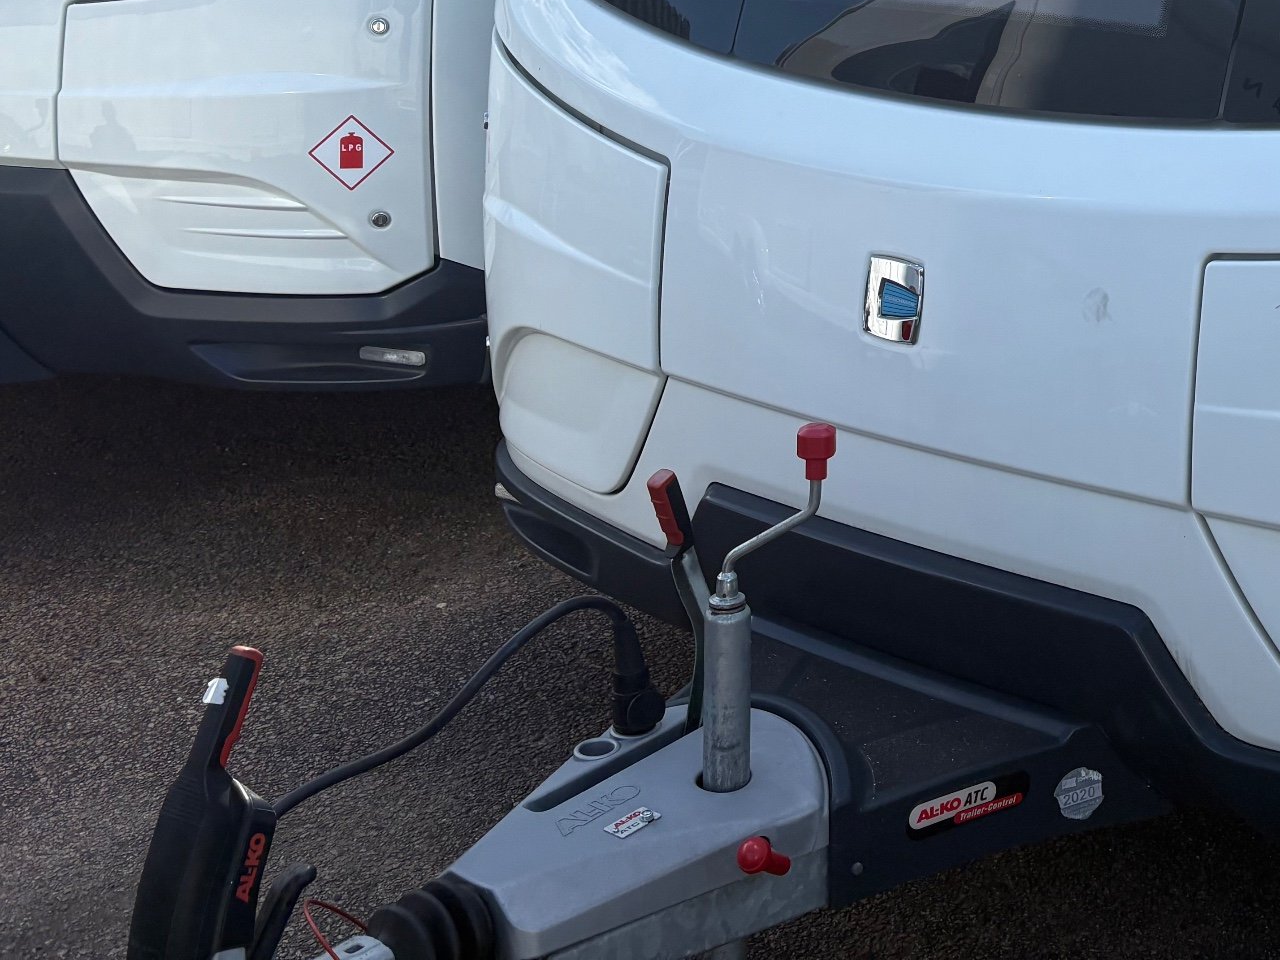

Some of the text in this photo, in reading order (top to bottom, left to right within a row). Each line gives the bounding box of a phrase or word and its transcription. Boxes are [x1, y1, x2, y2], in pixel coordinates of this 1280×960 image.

[341, 144, 362, 152] LPG
[917, 786, 989, 824] AL-KO ATC
[1063, 786, 1096, 807] 2020
[613, 810, 641, 829] AL-KO
[235, 832, 267, 904] AL-KO
